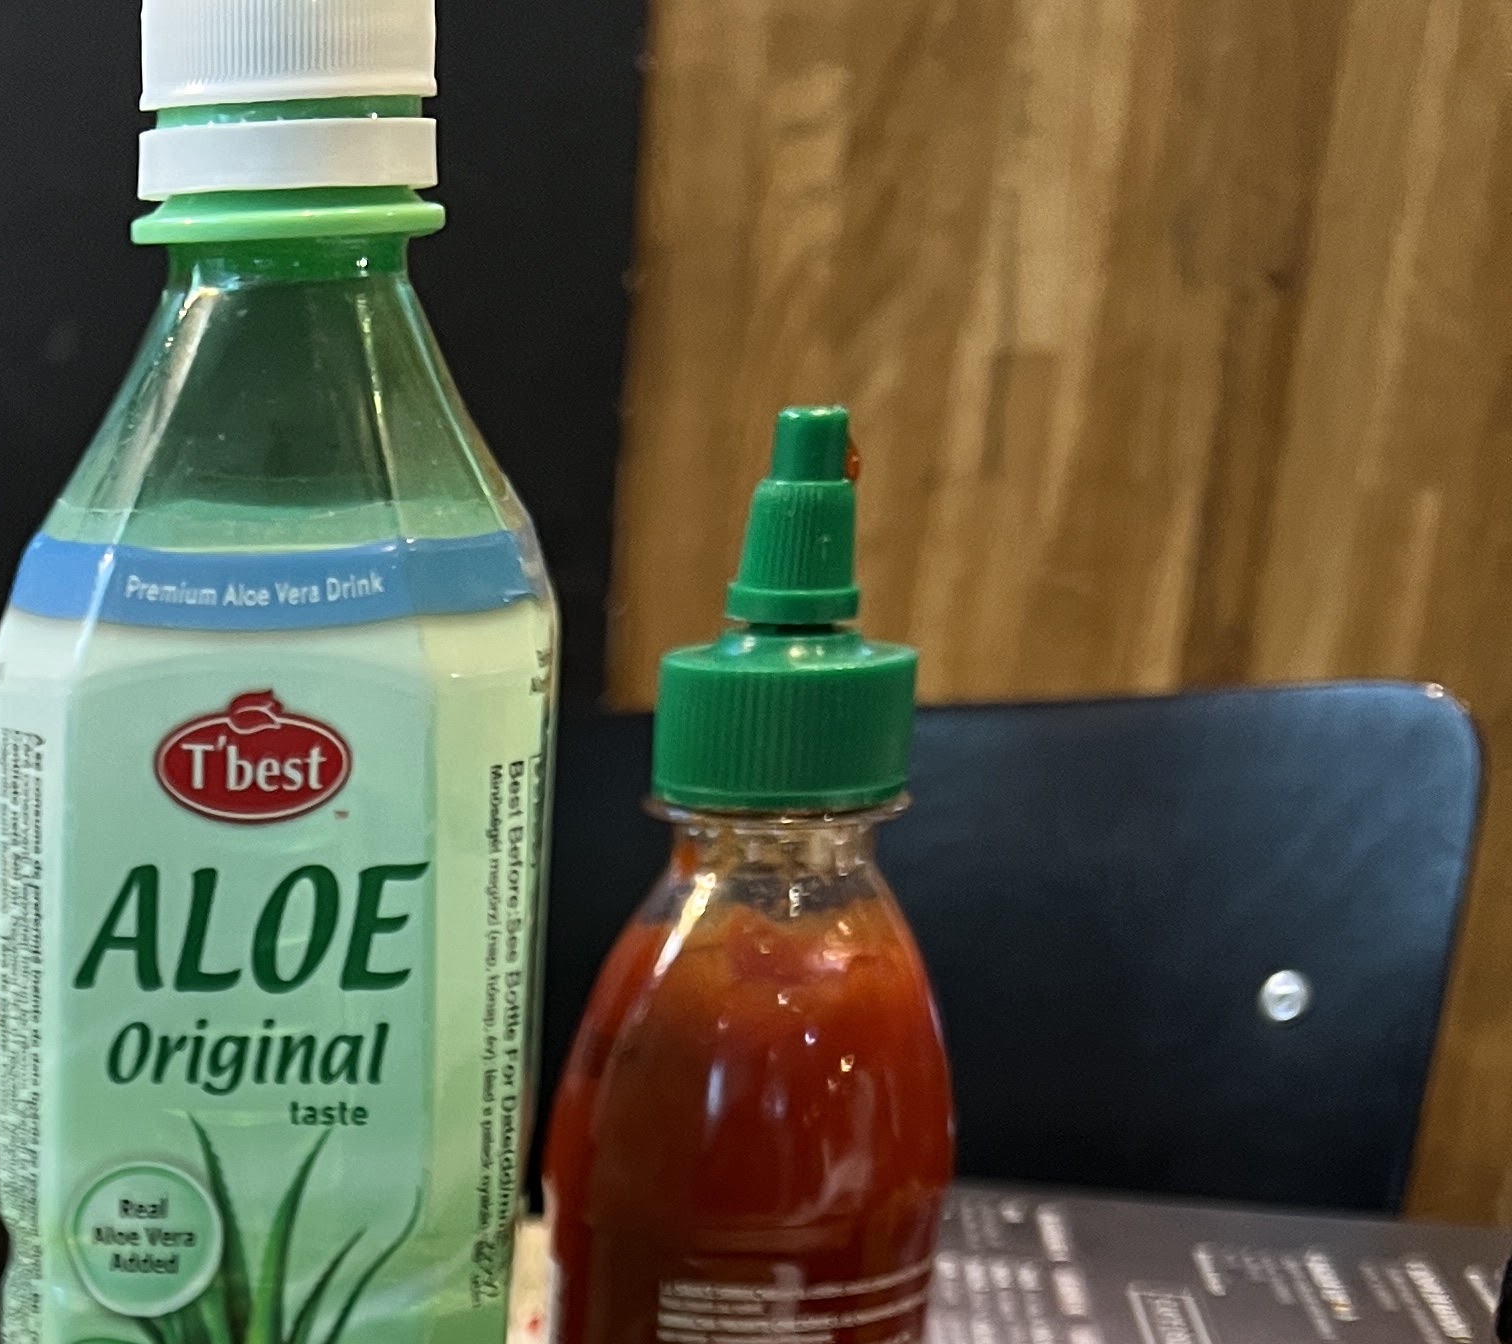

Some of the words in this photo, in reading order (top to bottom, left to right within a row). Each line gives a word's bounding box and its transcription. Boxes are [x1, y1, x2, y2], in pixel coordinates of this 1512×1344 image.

[125, 575, 217, 606] Premium
[223, 583, 270, 607] Aloe
[275, 582, 320, 605] Vera
[325, 572, 385, 601] Drink
[180, 735, 328, 792] T'best
[508, 761, 524, 817] Best
[72, 861, 430, 994] ALOE
[503, 971, 521, 1041] Bottle
[106, 1019, 389, 1096] Original
[501, 1049, 518, 1085] For
[289, 1101, 369, 1127] taste
[119, 1197, 169, 1219] Real
[92, 1225, 141, 1248] Aloe
[147, 1226, 196, 1248] Vera
[110, 1253, 179, 1275] Added
